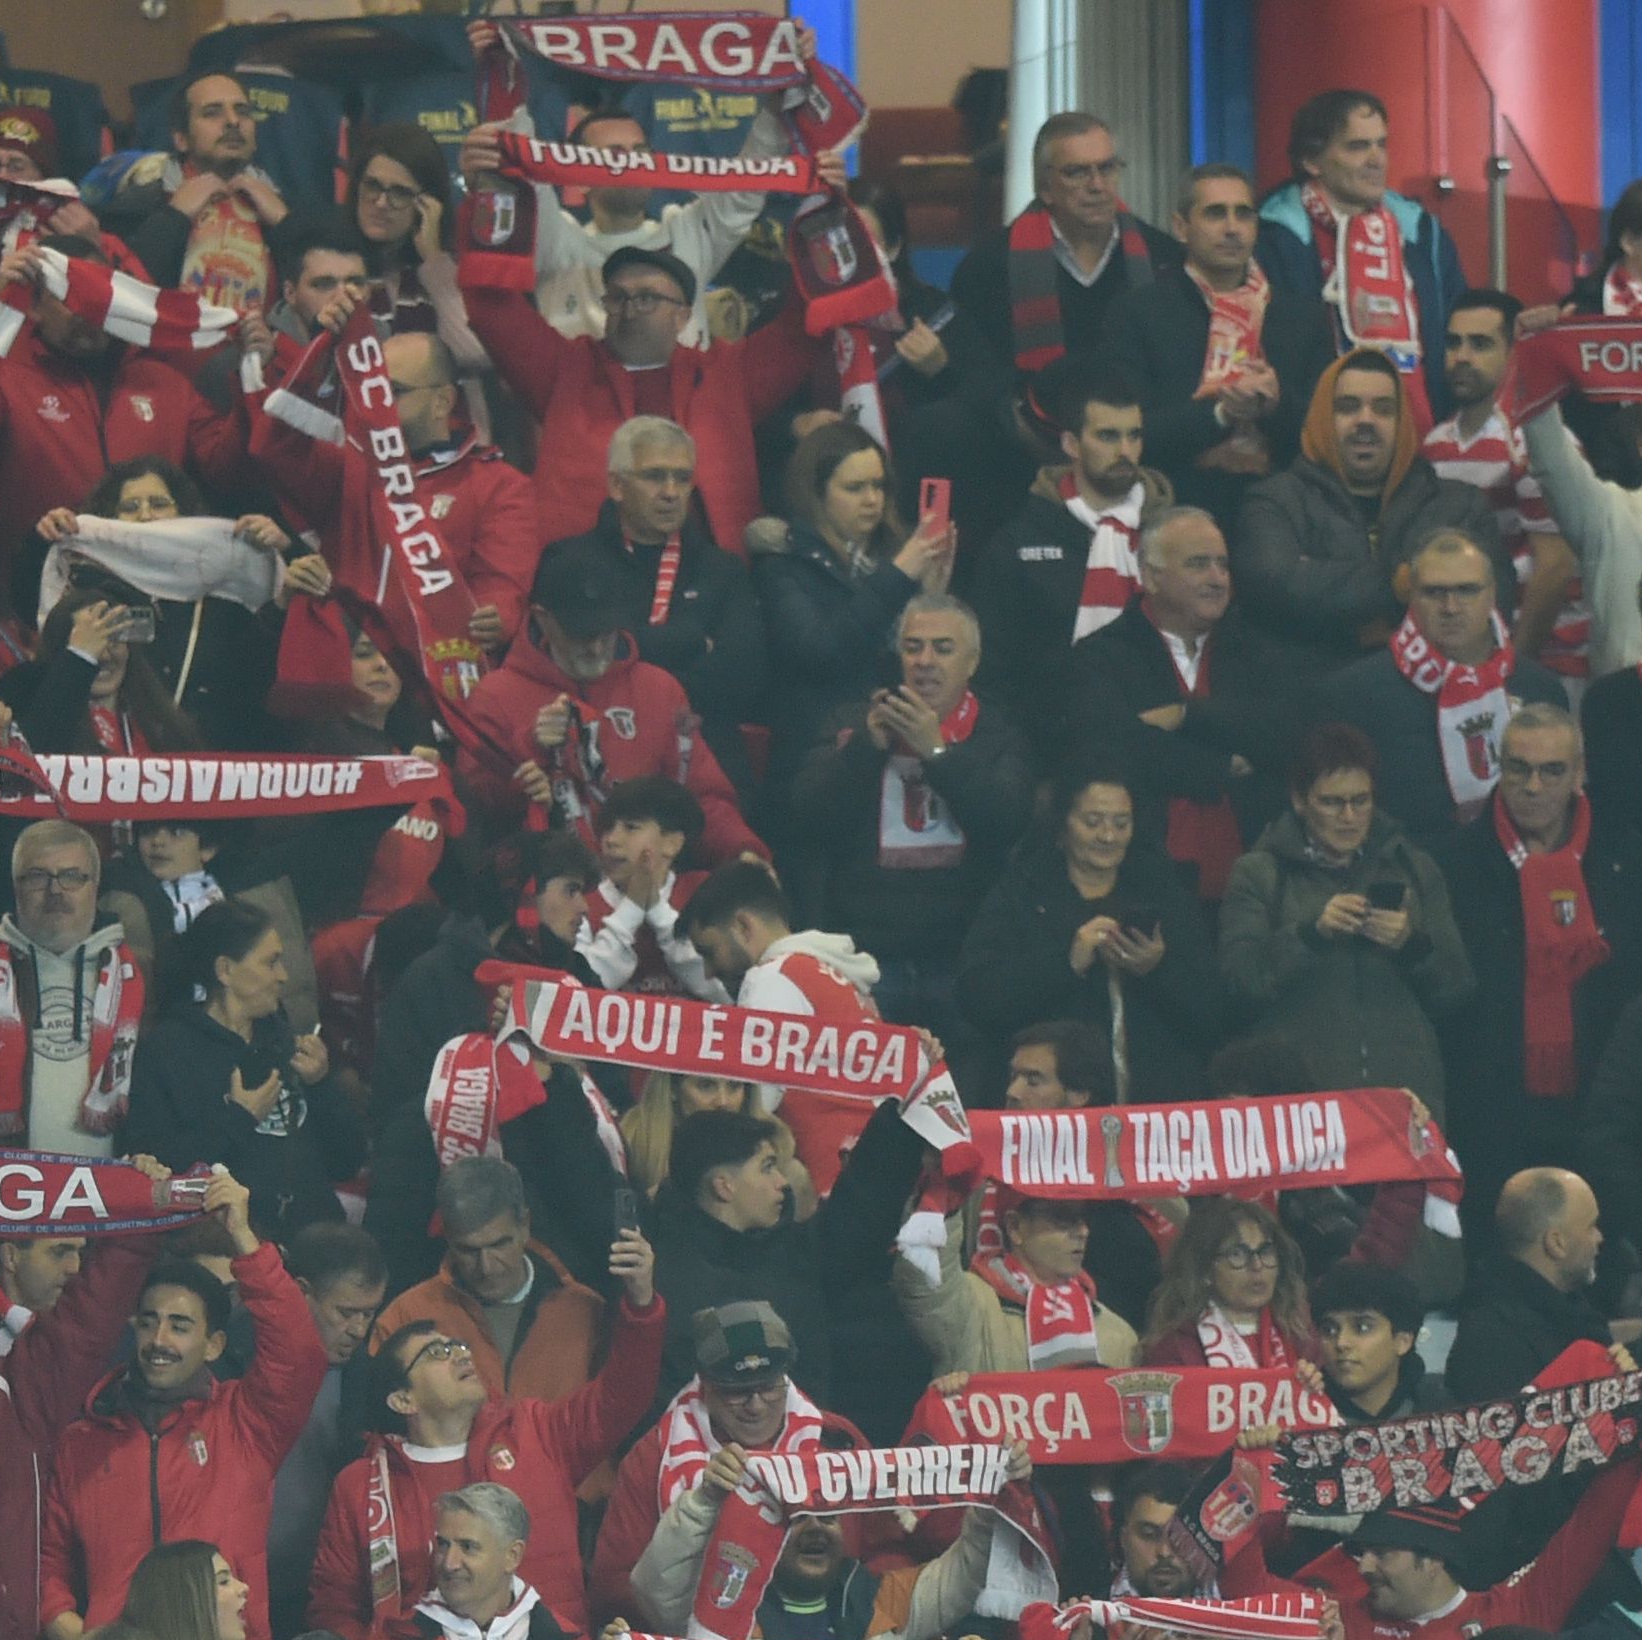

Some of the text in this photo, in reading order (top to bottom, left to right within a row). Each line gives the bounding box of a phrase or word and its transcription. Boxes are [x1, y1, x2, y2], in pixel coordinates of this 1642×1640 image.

[531, 22, 807, 77] BRAGA
[347, 335, 455, 599] SC BRAGA
[561, 990, 906, 1086] AQUI É BRAGA
[445, 1065, 491, 1140] BRAGA
[999, 1099, 1347, 1193] FINAL TAÇA DA LIGA
[945, 1379, 1345, 1464] FORÇA BRAG
[1290, 1371, 1642, 1471] SPORTING CLUBE
[1344, 1423, 1610, 1515] BRAGA
